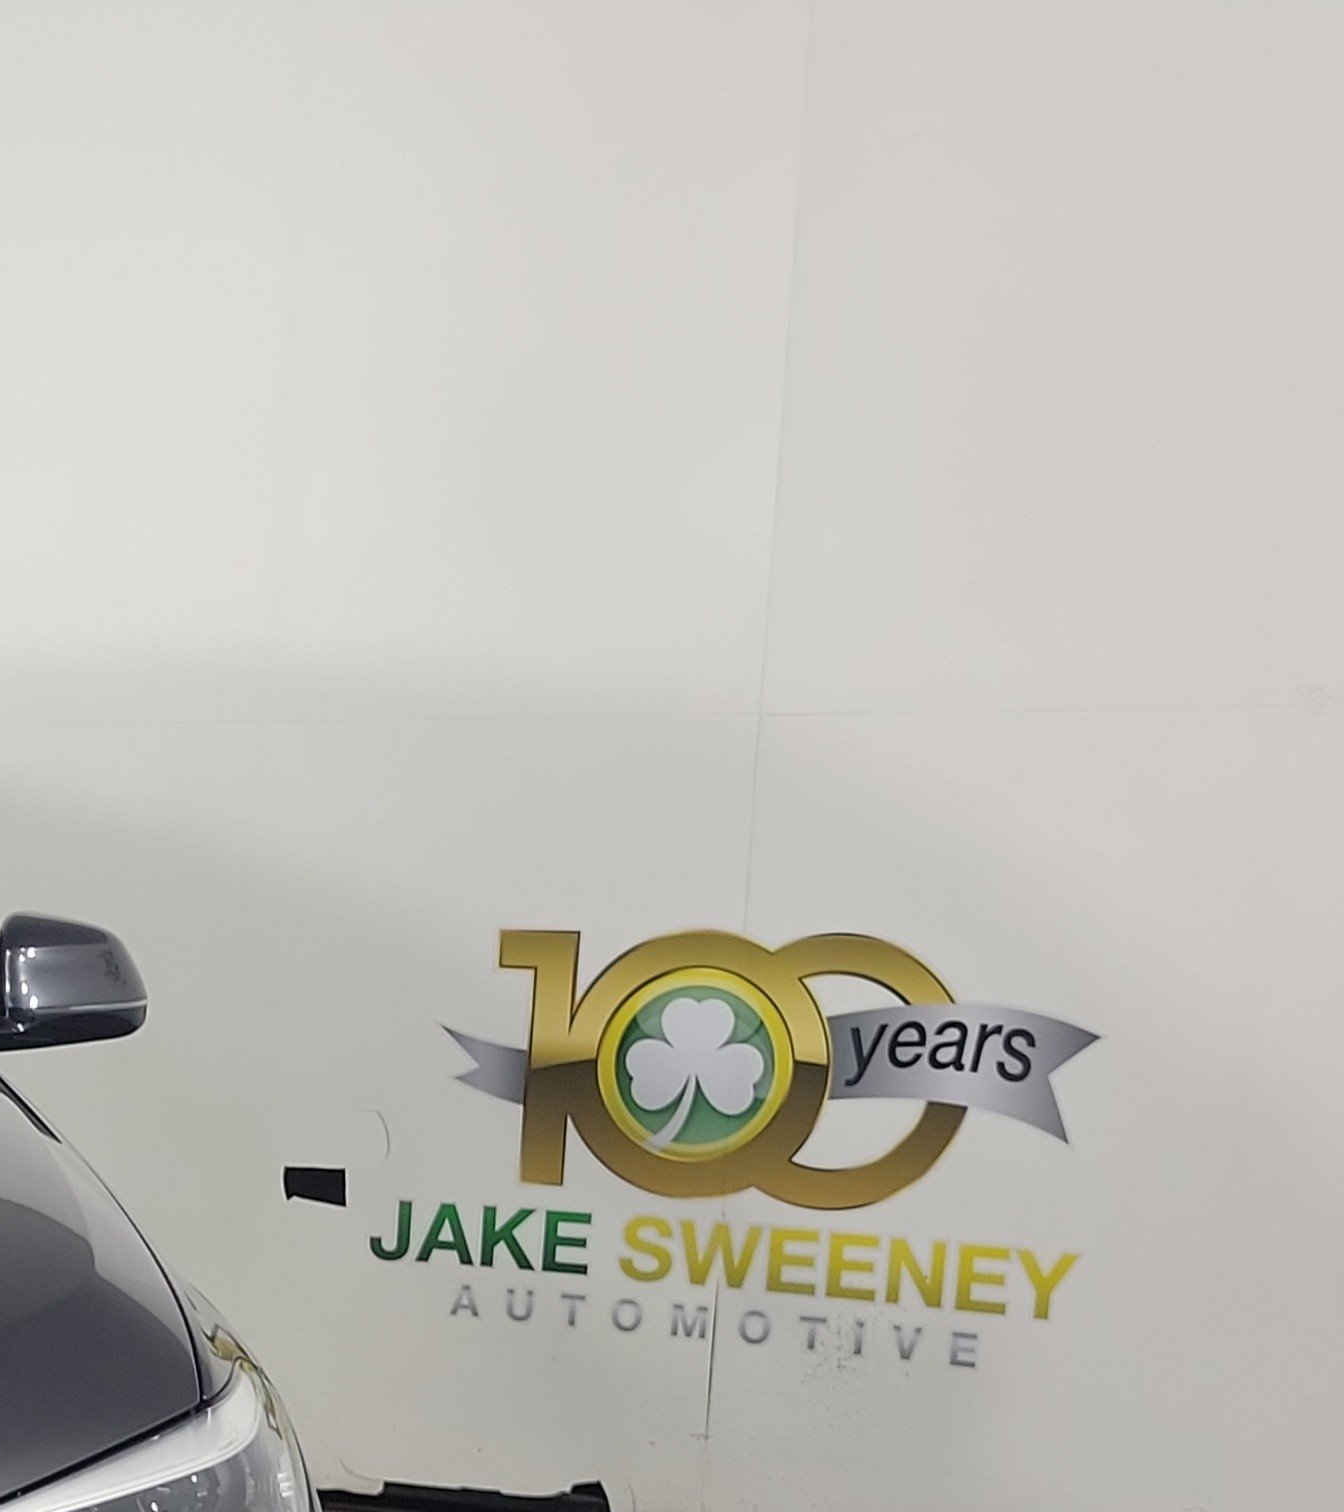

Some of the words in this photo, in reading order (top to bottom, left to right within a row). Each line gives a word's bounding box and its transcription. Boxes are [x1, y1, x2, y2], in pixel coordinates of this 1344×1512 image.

[498, 928, 968, 1211] 100
[844, 1018, 1036, 1087] years
[369, 1200, 593, 1276] JAKE
[618, 1215, 1079, 1321] SWEENEY
[449, 1284, 980, 1369] AUTOMOTIVE
